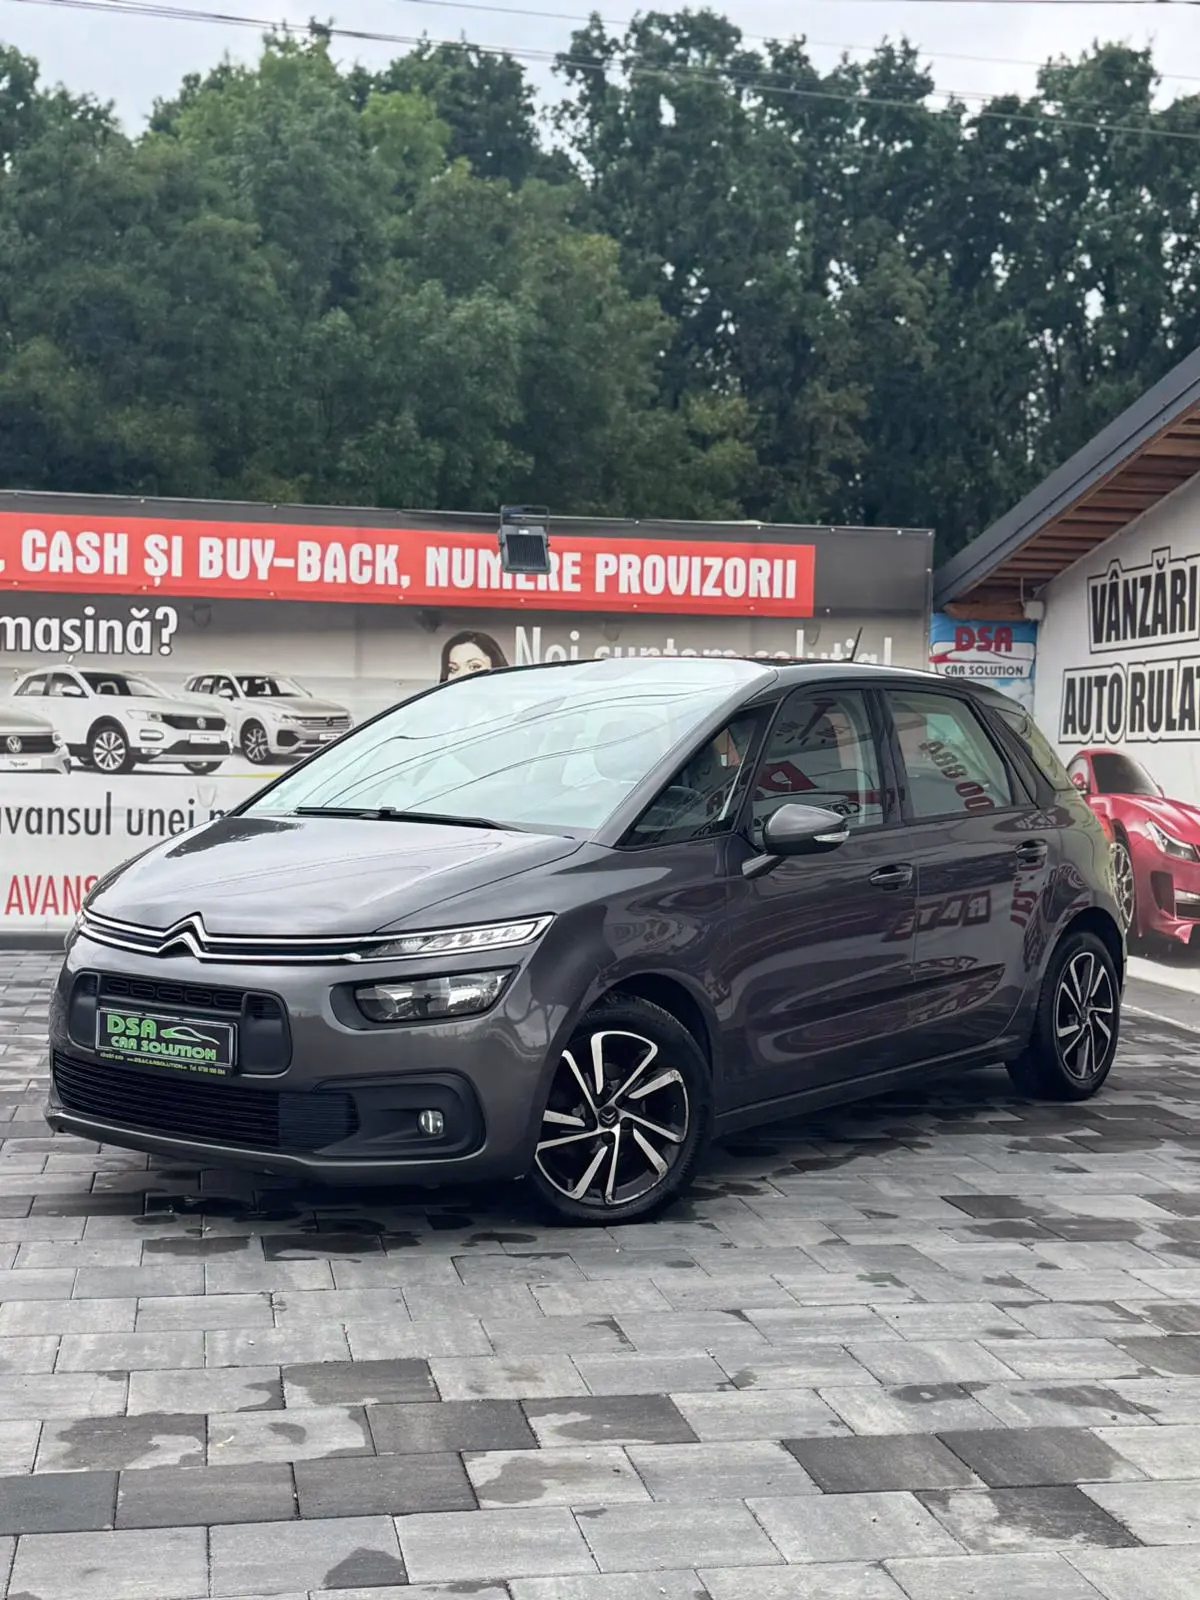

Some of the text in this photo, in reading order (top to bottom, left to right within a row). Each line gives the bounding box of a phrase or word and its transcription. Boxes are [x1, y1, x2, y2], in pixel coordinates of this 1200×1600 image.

[21, 528, 129, 576] CASH
[143, 533, 183, 588] ȘI
[198, 536, 411, 589] BUY-BACK,
[594, 552, 797, 600] PROVIZORII
[1091, 557, 1198, 645] VÂNZĂRI
[954, 625, 1013, 653] DSA
[944, 664, 1024, 677] CAR SOLUTION
[1062, 665, 1200, 736] AUTO RULA
[0, 791, 195, 836] vansul unei
[106, 1014, 157, 1039] DSA
[111, 1036, 138, 1050] CAR
[141, 1040, 217, 1061] SOLUTION
